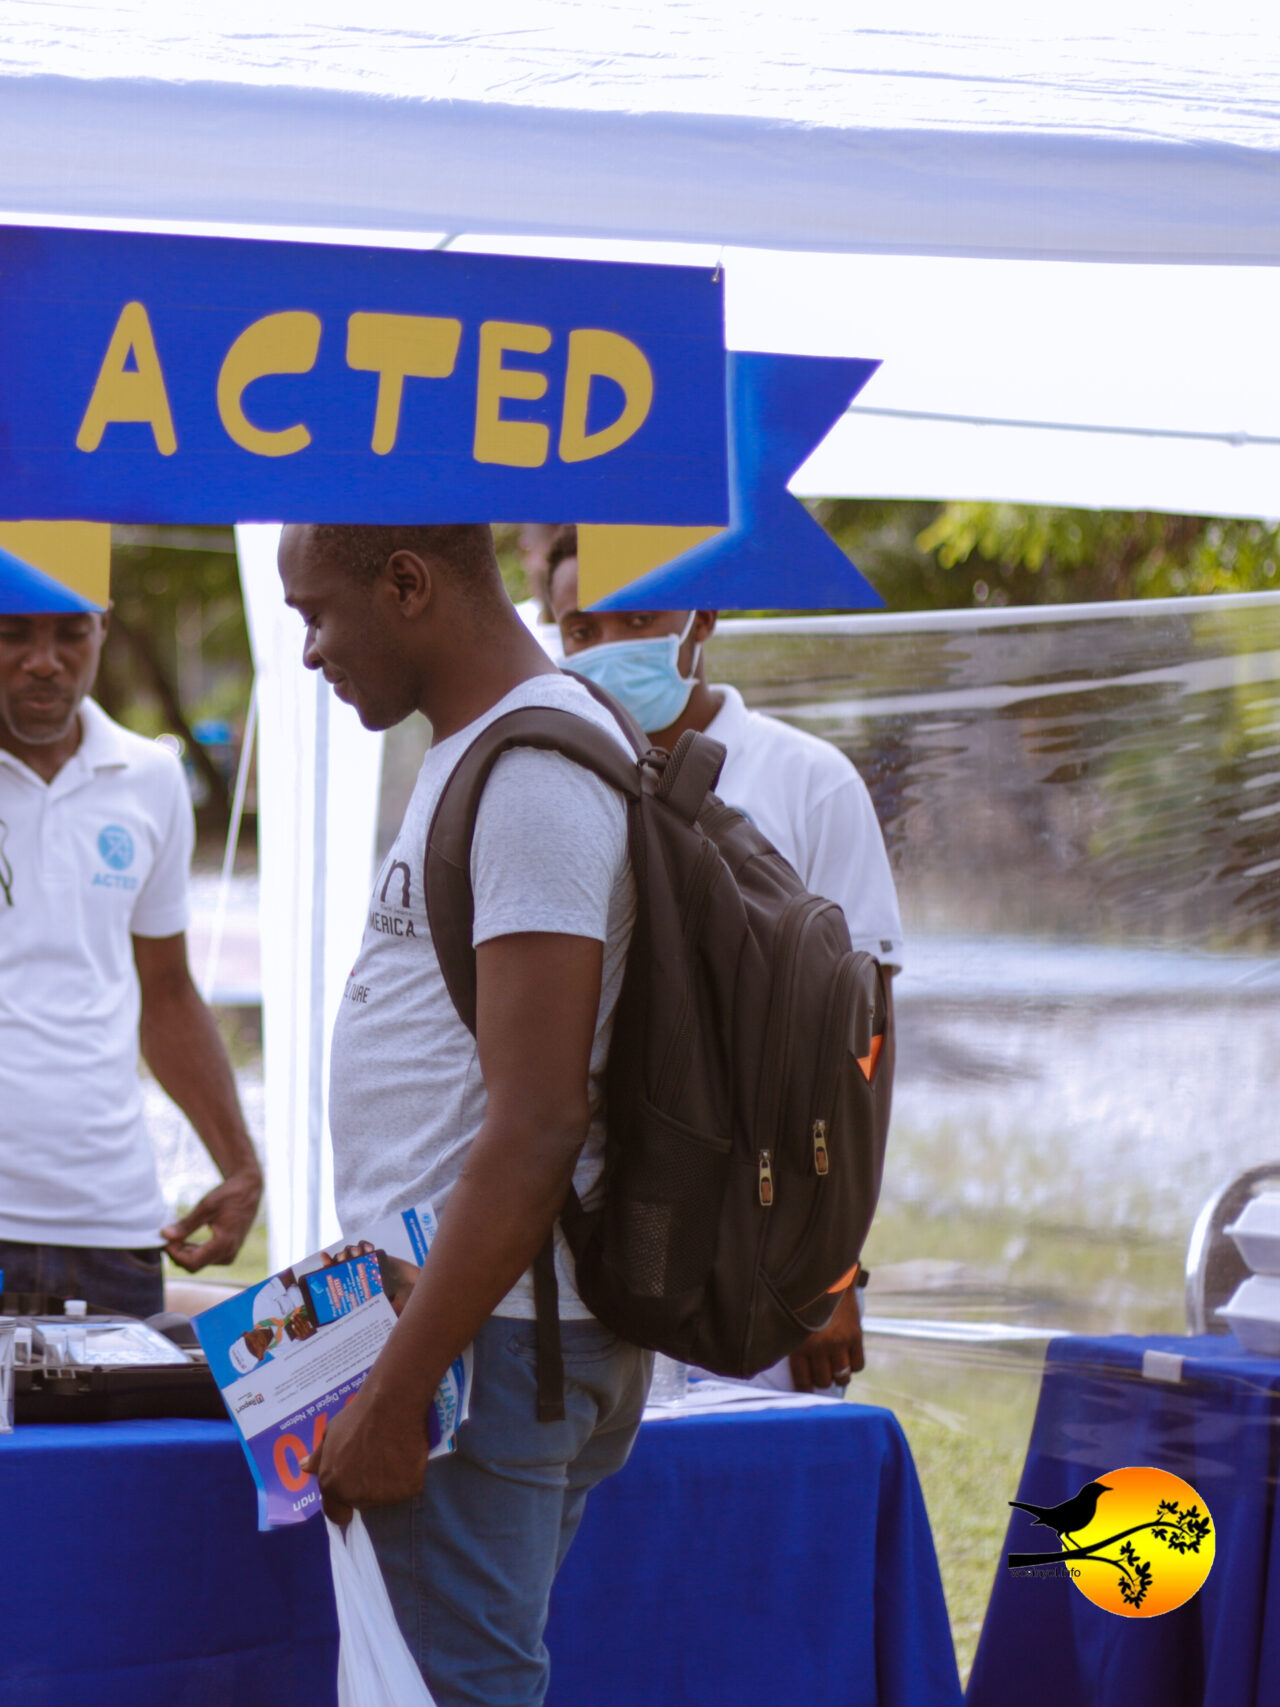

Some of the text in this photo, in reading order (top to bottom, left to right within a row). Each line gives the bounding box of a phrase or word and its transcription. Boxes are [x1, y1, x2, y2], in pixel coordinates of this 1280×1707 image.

[75, 301, 654, 468] ACTED
[314, 1391, 340, 1411] Digicel
[292, 1491, 317, 1511] nan
